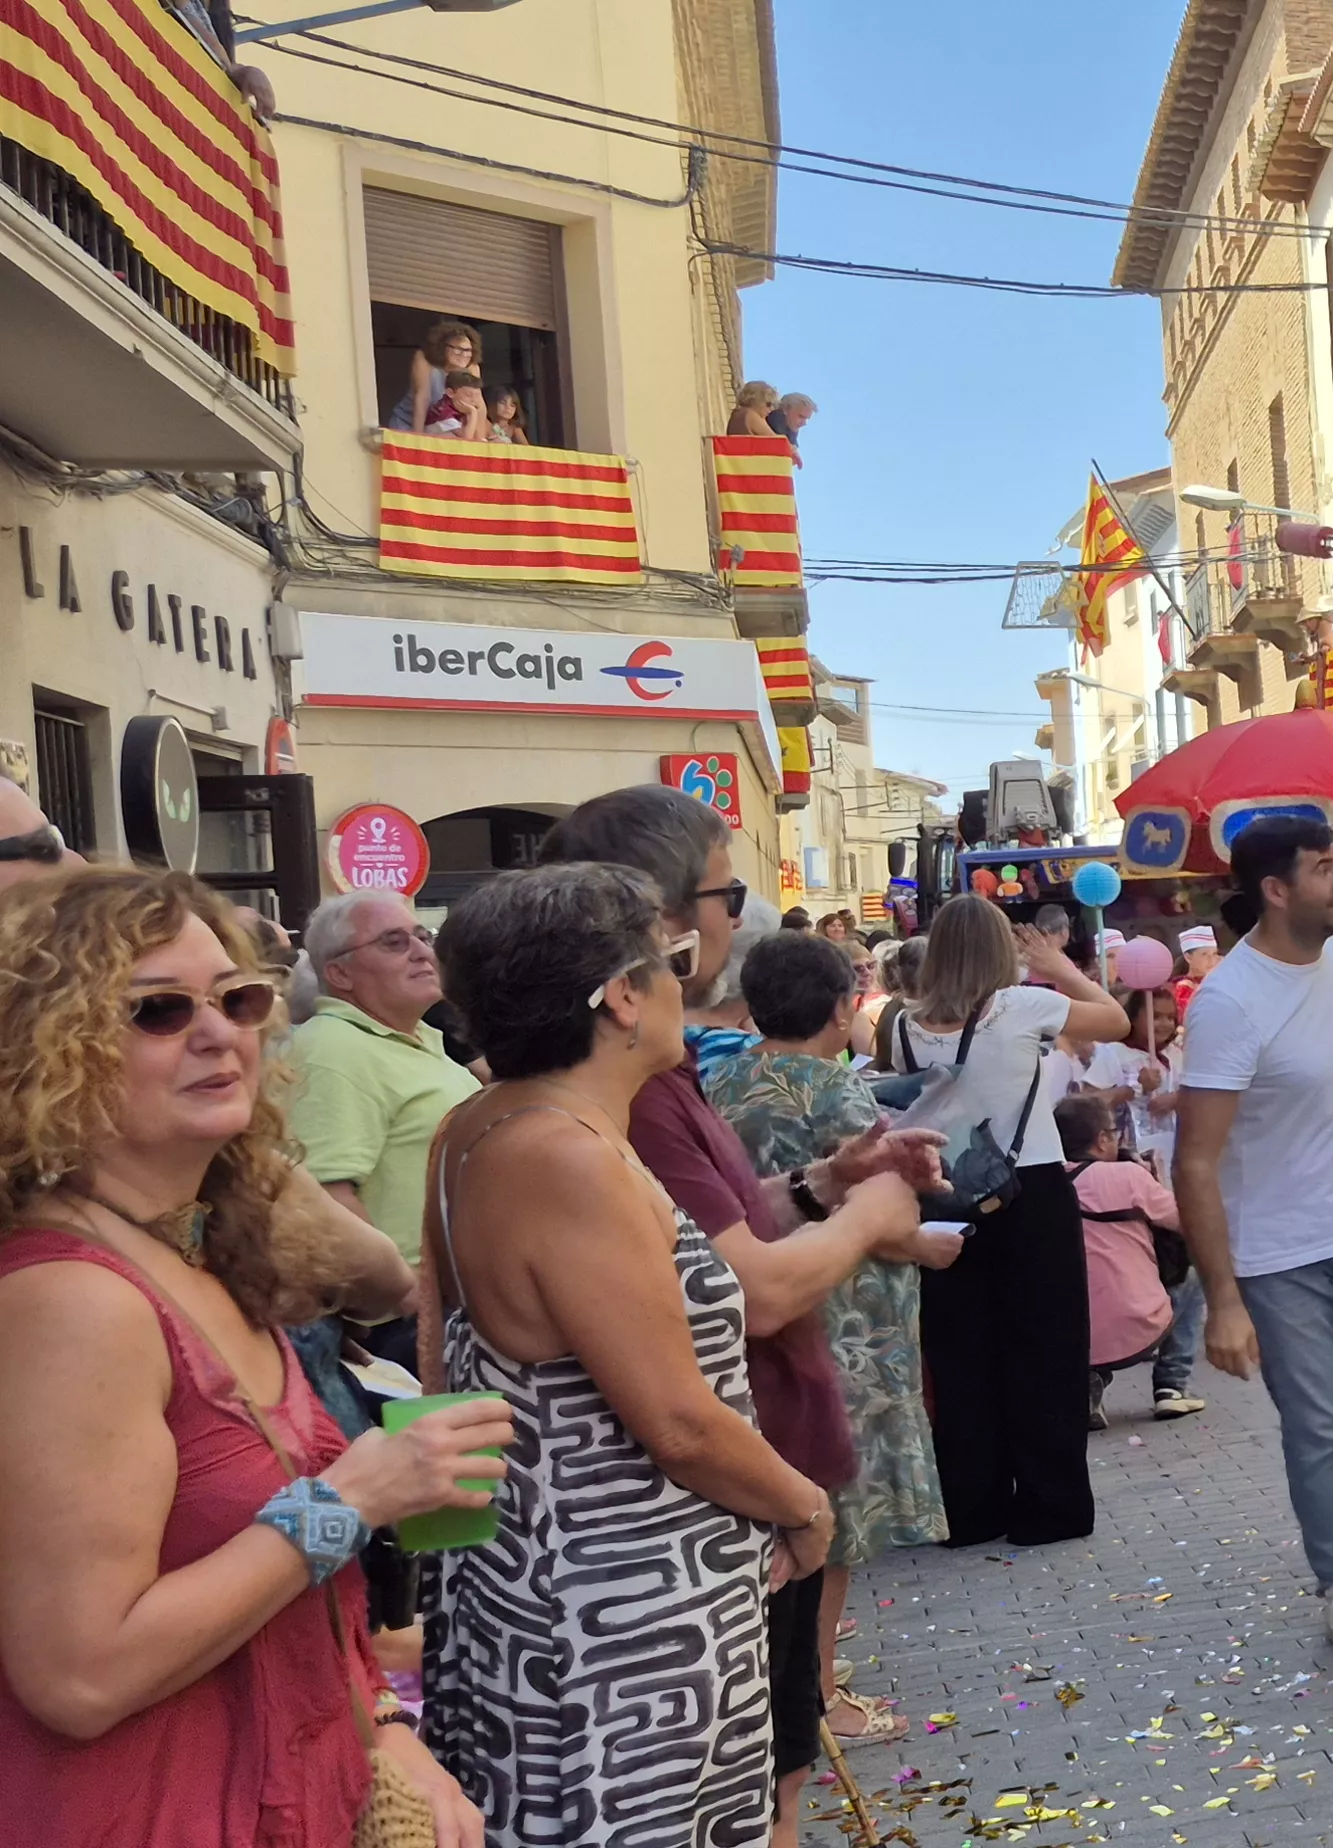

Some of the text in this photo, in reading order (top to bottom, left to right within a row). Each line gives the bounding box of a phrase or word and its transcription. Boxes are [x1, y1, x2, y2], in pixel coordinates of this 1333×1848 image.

[19, 525, 257, 680] LA GATERA
[393, 633, 583, 690] iberCaja
[352, 867, 409, 888] LOBAS
